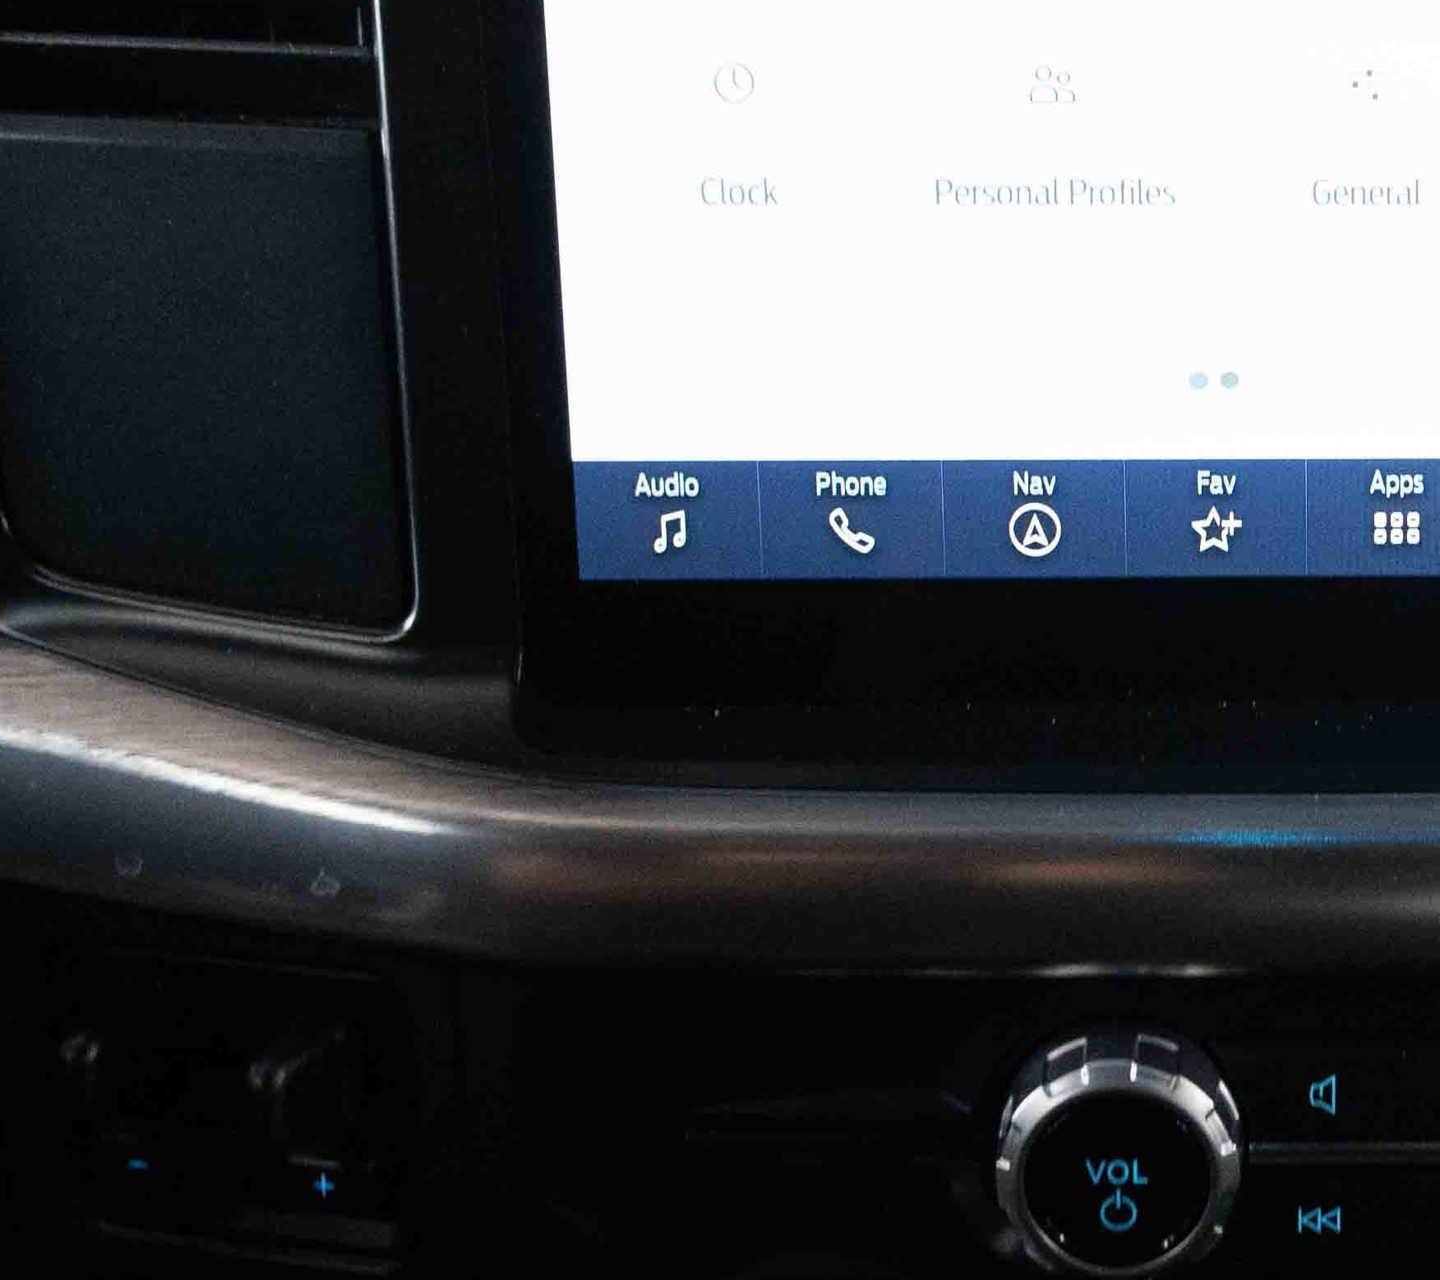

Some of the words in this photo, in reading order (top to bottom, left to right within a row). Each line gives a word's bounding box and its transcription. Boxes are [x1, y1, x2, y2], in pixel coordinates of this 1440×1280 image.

[700, 176, 778, 207] Clock
[935, 176, 1059, 207] Personal
[1069, 177, 1176, 207] Profiles
[1312, 177, 1420, 207] General
[634, 471, 700, 498] Audio
[815, 470, 887, 497] Phone
[1013, 470, 1056, 496] Nav
[1197, 469, 1237, 496] Fav
[1369, 468, 1425, 499] Apps
[1086, 1159, 1149, 1185] VOL
